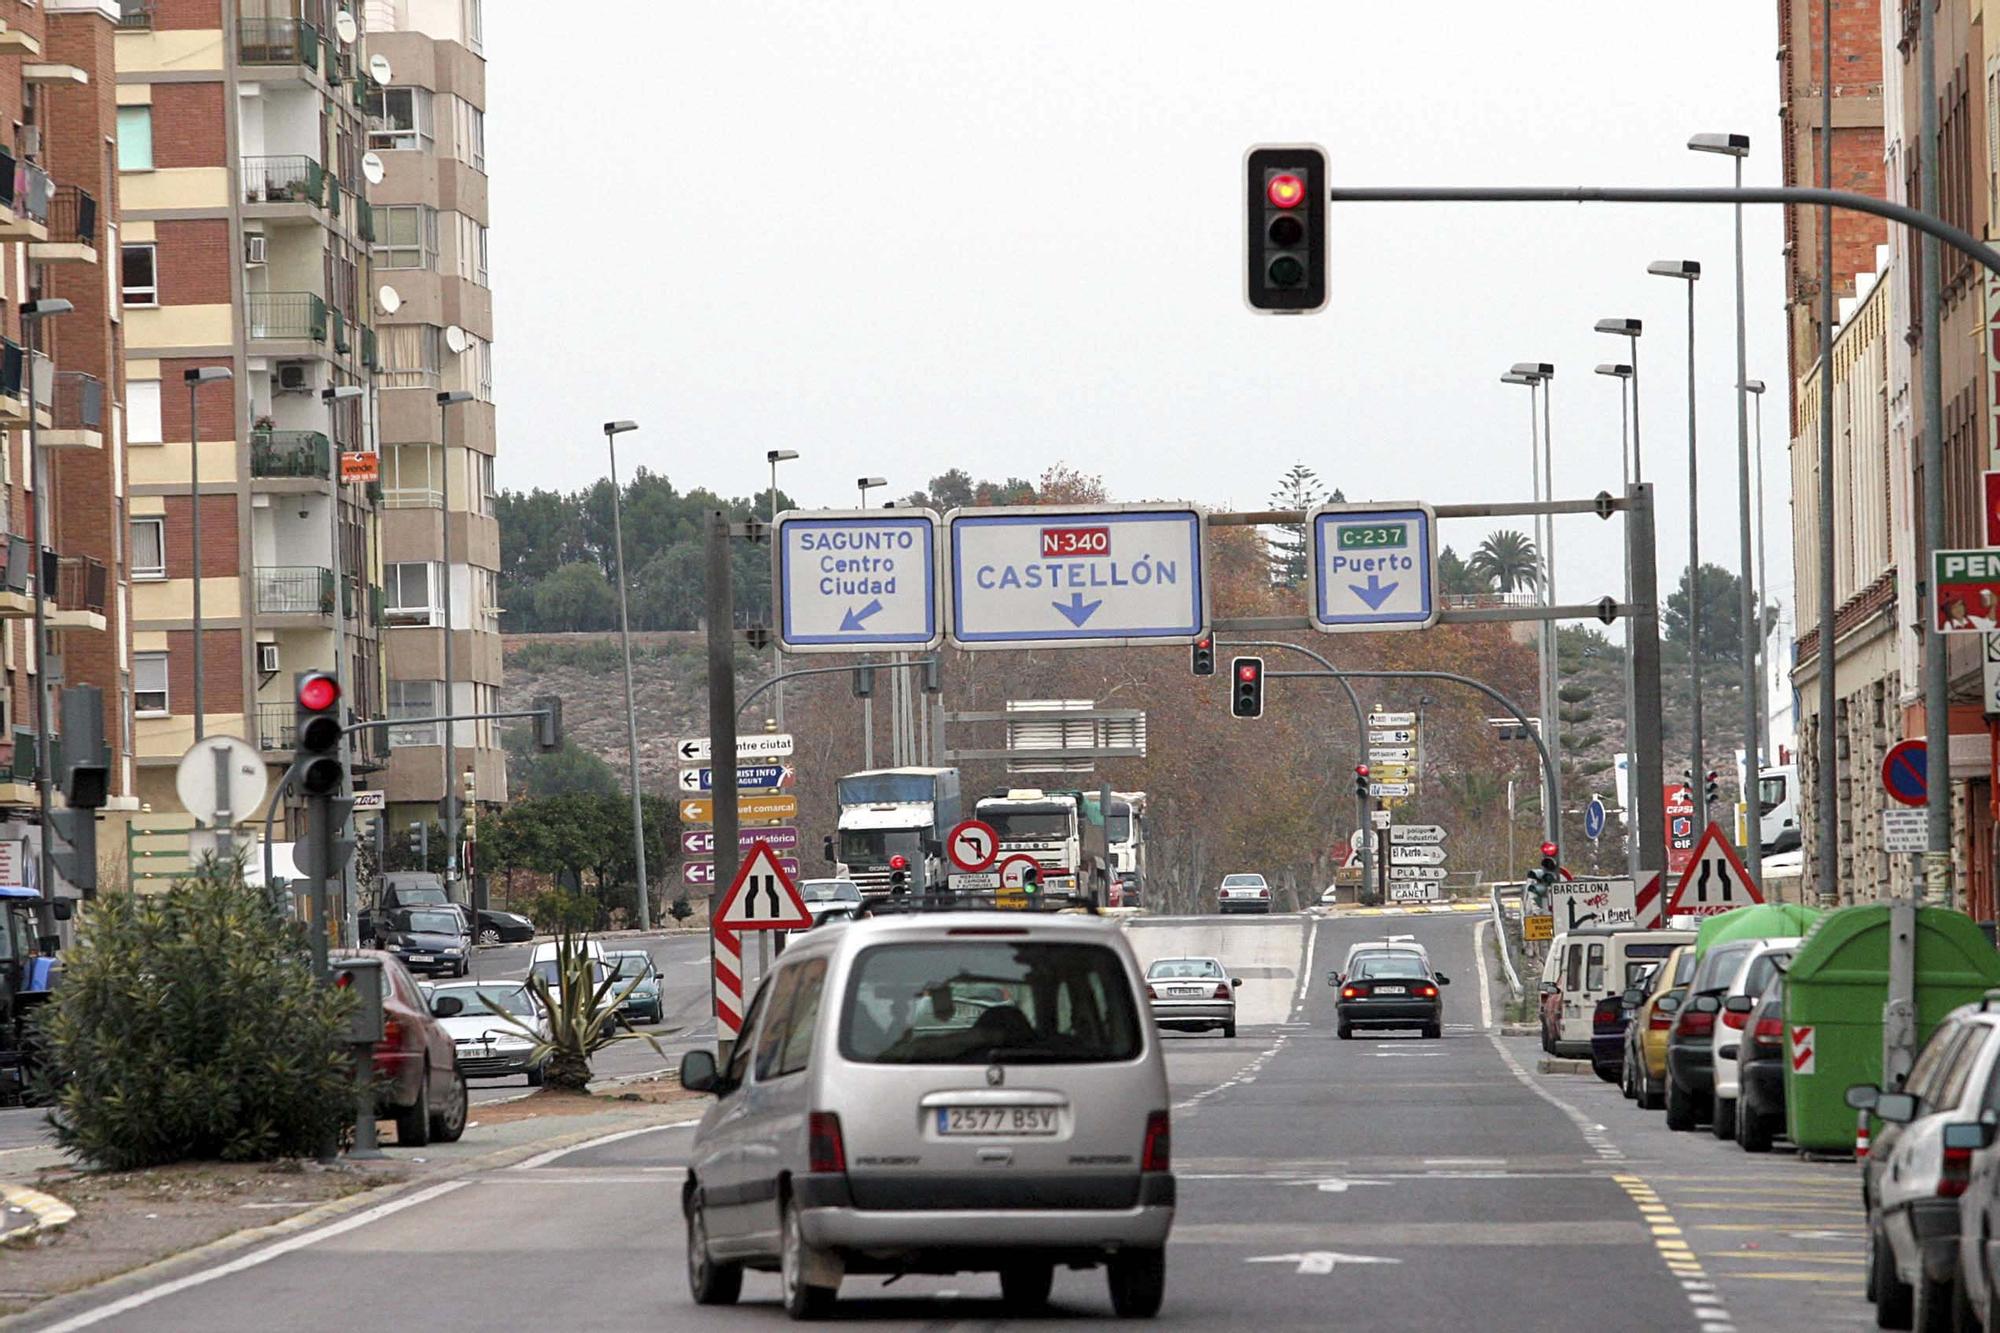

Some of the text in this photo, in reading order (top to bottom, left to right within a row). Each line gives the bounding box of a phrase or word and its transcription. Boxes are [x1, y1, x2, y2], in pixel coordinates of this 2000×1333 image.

[800, 531, 913, 551] SAGUNTO
[1043, 533, 1108, 552] N-340
[1343, 528, 1402, 545] C-237
[820, 555, 895, 573] Centro
[1332, 553, 1413, 574] Puerto
[976, 554, 1176, 589] CASTELLÓN
[819, 577, 896, 595] Ciudad
[760, 739, 792, 750] ciutat
[756, 768, 777, 777] INFO
[738, 777, 762, 785] AGUNT
[753, 803, 795, 814] comarcal
[1674, 839, 1691, 849] elf
[1400, 847, 1422, 858] Puerto
[1395, 890, 1424, 898] CANET
[1553, 883, 1610, 895] BARCELONA
[951, 1108, 1051, 1130] 2577 BSV
